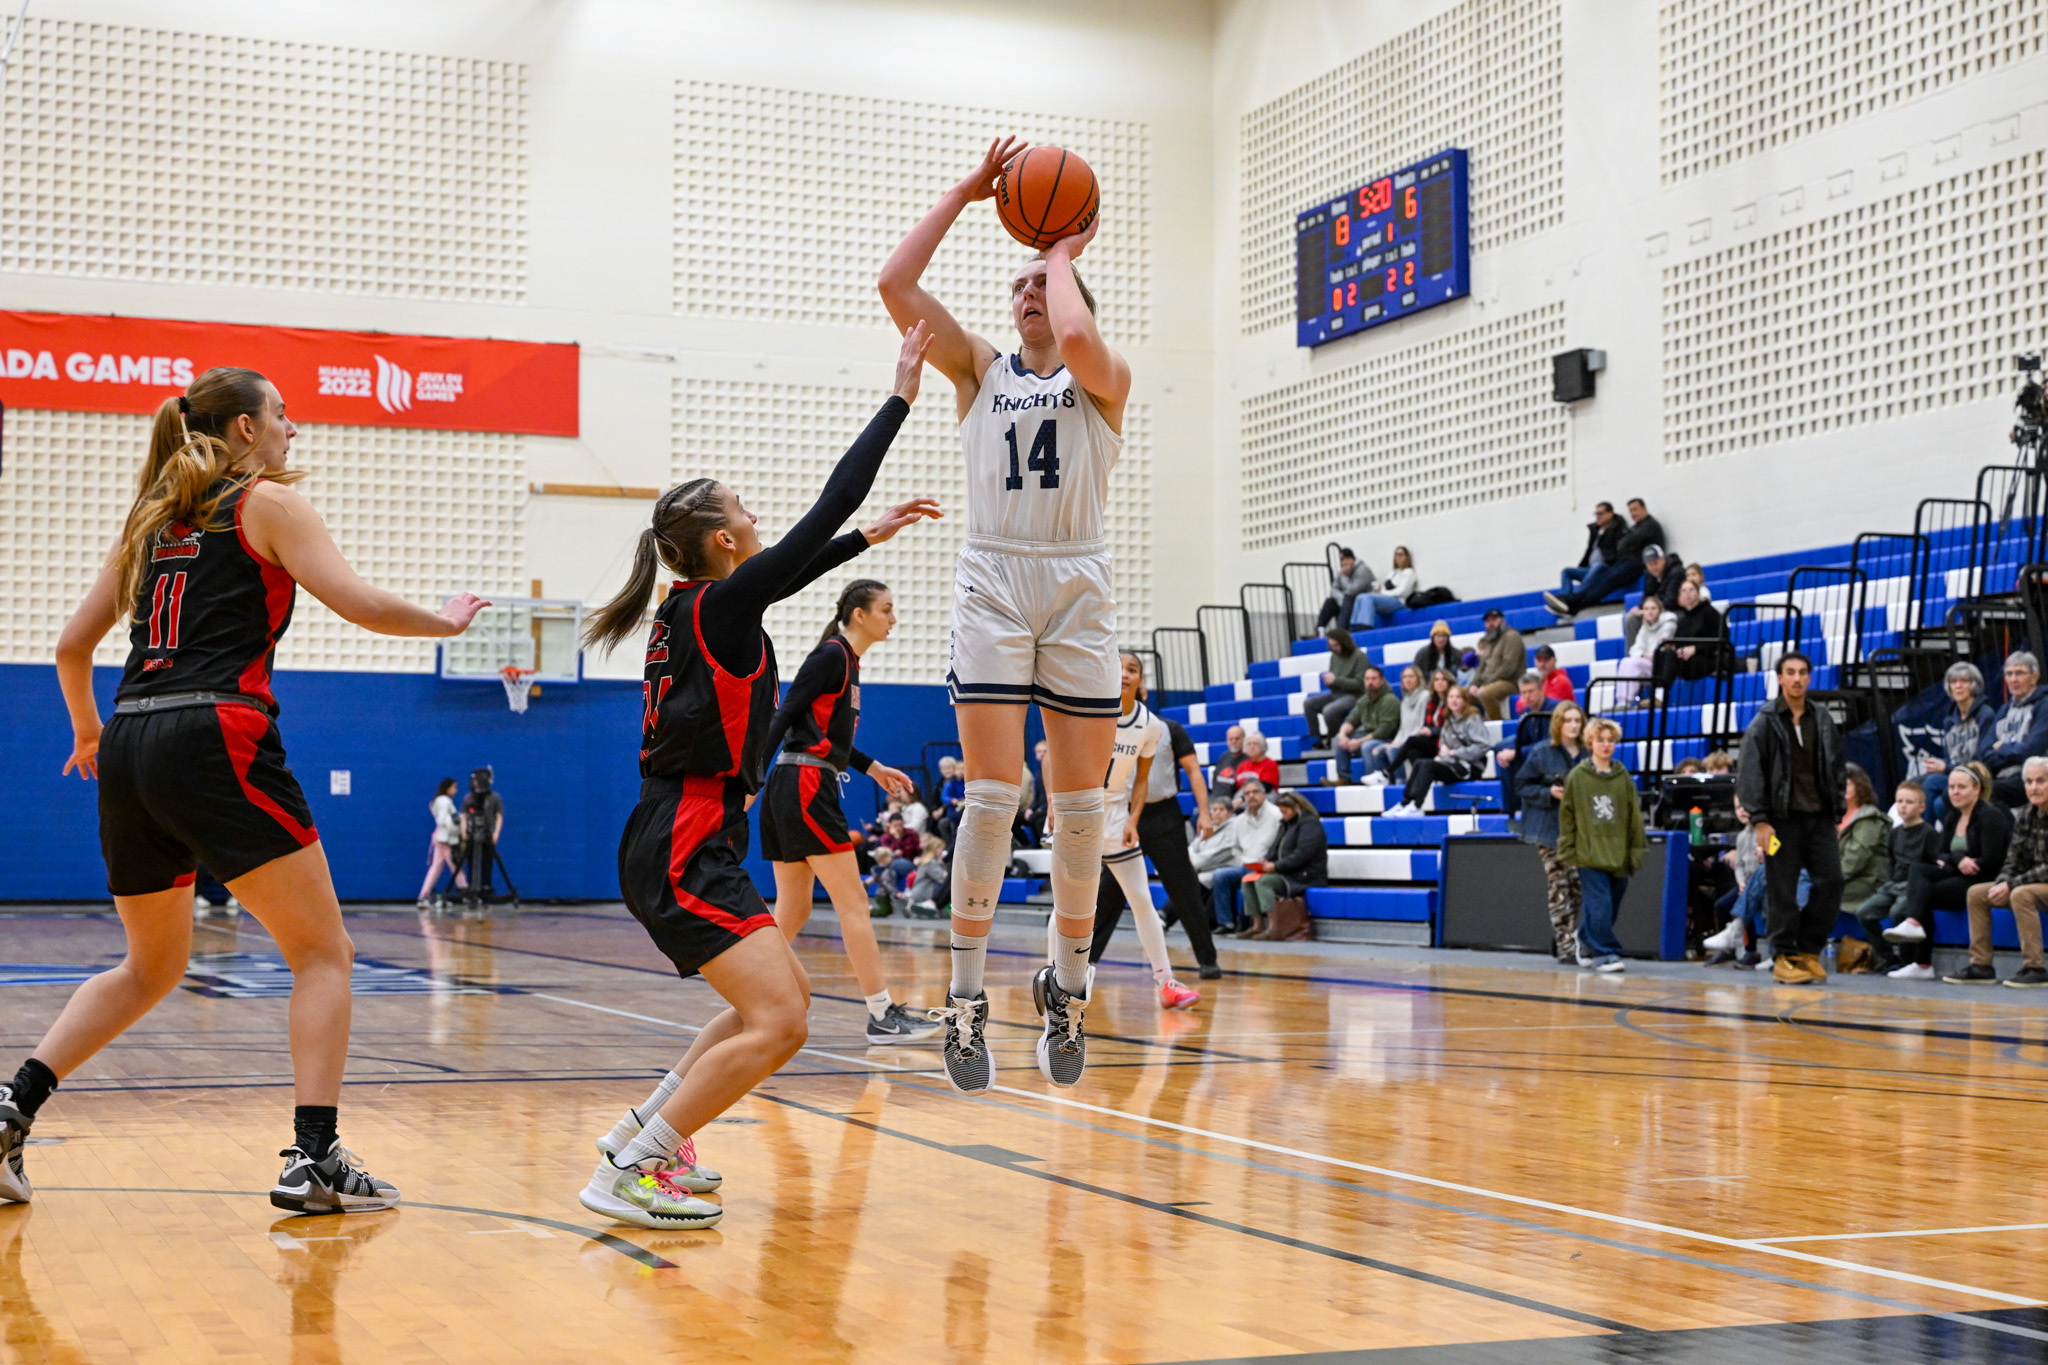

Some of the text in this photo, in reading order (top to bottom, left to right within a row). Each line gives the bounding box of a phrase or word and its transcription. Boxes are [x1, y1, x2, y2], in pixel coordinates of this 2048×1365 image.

[1359, 177, 1391, 218] 5:20
[1405, 186, 1416, 218] 6
[1336, 214, 1349, 245] 8
[1332, 261, 1414, 310] 0 2 2 2
[65, 352, 194, 386] GAMES
[318, 366, 371, 377] NIAGARA
[318, 376, 371, 396] 2022
[416, 381, 463, 393] CANADA
[416, 391, 455, 401] GAMES
[992, 389, 1075, 414] KNIGHTS
[1005, 419, 1060, 491] 14
[148, 571, 187, 648] 11
